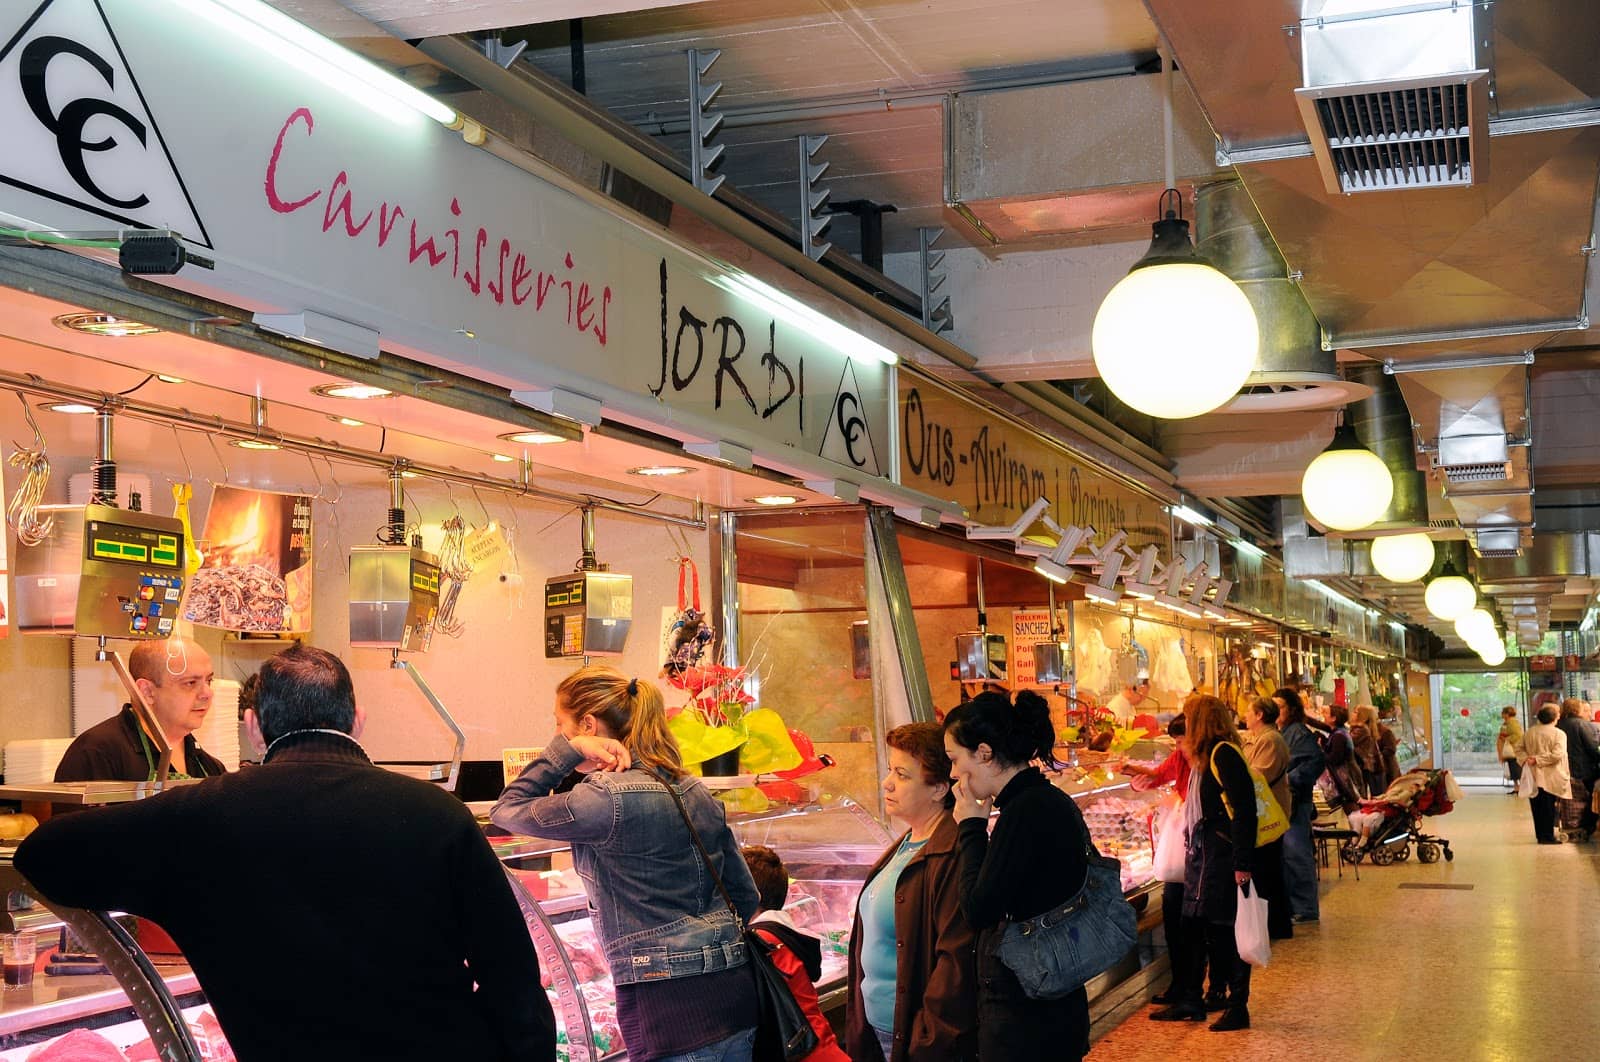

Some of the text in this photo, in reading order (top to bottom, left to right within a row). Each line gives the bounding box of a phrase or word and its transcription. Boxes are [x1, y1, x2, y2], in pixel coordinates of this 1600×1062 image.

[264, 106, 804, 436] Carnisseries JORDI
[1015, 622, 1050, 636] SANCHEZ
[1016, 645, 1033, 653] Poll
